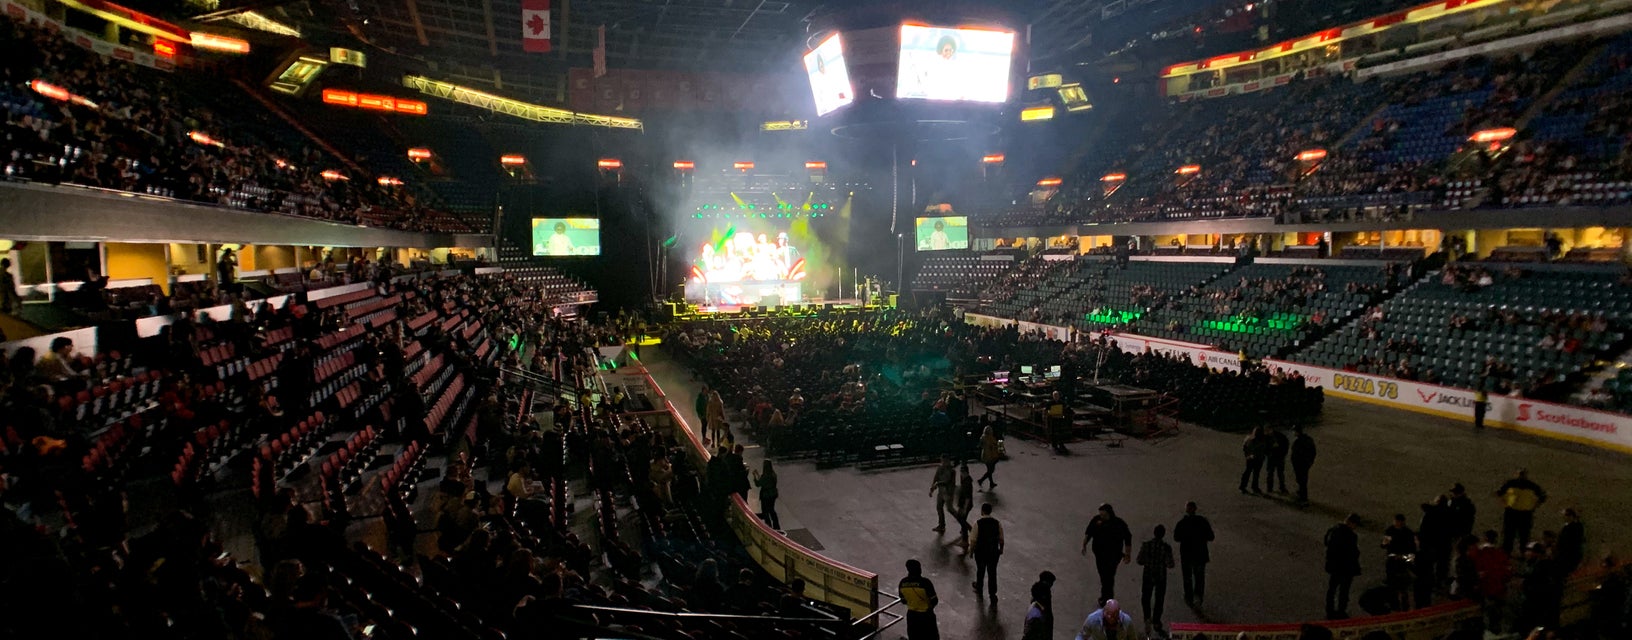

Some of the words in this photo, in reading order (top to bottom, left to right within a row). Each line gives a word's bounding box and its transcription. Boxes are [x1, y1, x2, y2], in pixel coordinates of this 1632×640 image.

[1219, 357, 1241, 367] CANAD
[1334, 373, 1374, 395] PIZZA
[1378, 380, 1398, 399] 73
[1438, 393, 1461, 407] JACK
[1537, 410, 1618, 433] Scotiabank
